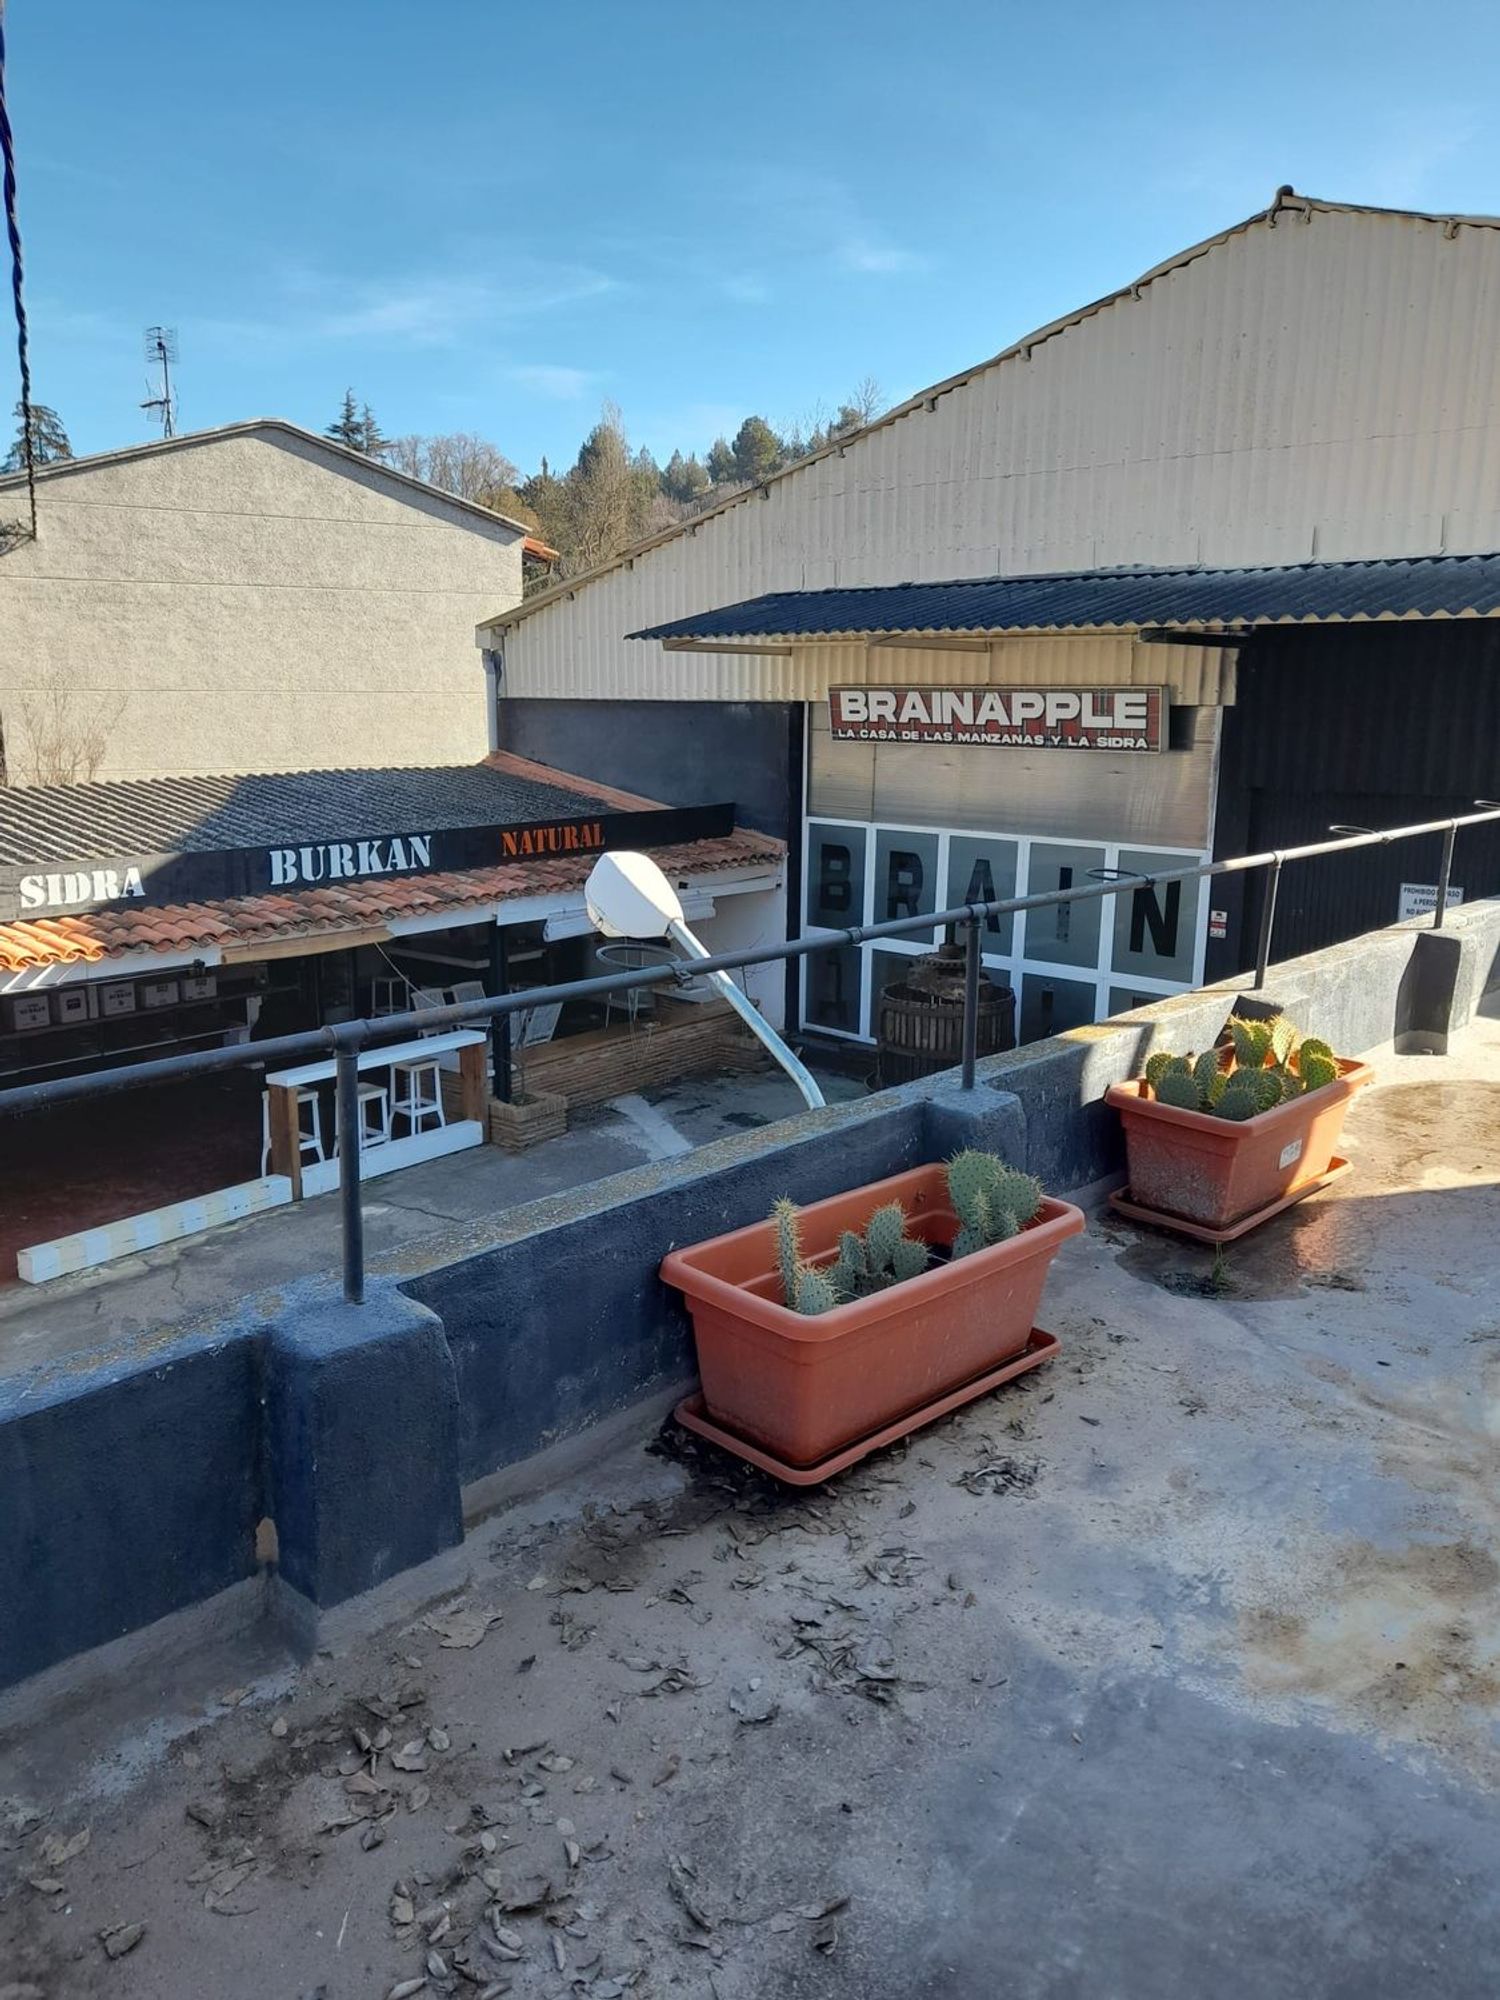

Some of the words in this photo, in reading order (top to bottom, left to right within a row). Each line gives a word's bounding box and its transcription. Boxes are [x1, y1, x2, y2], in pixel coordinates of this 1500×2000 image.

[840, 690, 1148, 729] BRAINAPPLE
[838, 729, 855, 738] LA
[859, 730, 897, 739] CASA
[901, 731, 920, 740] DE
[924, 731, 953, 742] LAS
[957, 733, 1044, 746] MANZANAS
[1051, 735, 1062, 746] Y
[1067, 736, 1090, 747] LA
[1096, 736, 1148, 749] SIDRA
[19, 867, 146, 909] SIDRA
[269, 835, 432, 885] BURKAN
[501, 823, 606, 857] NATURAL
